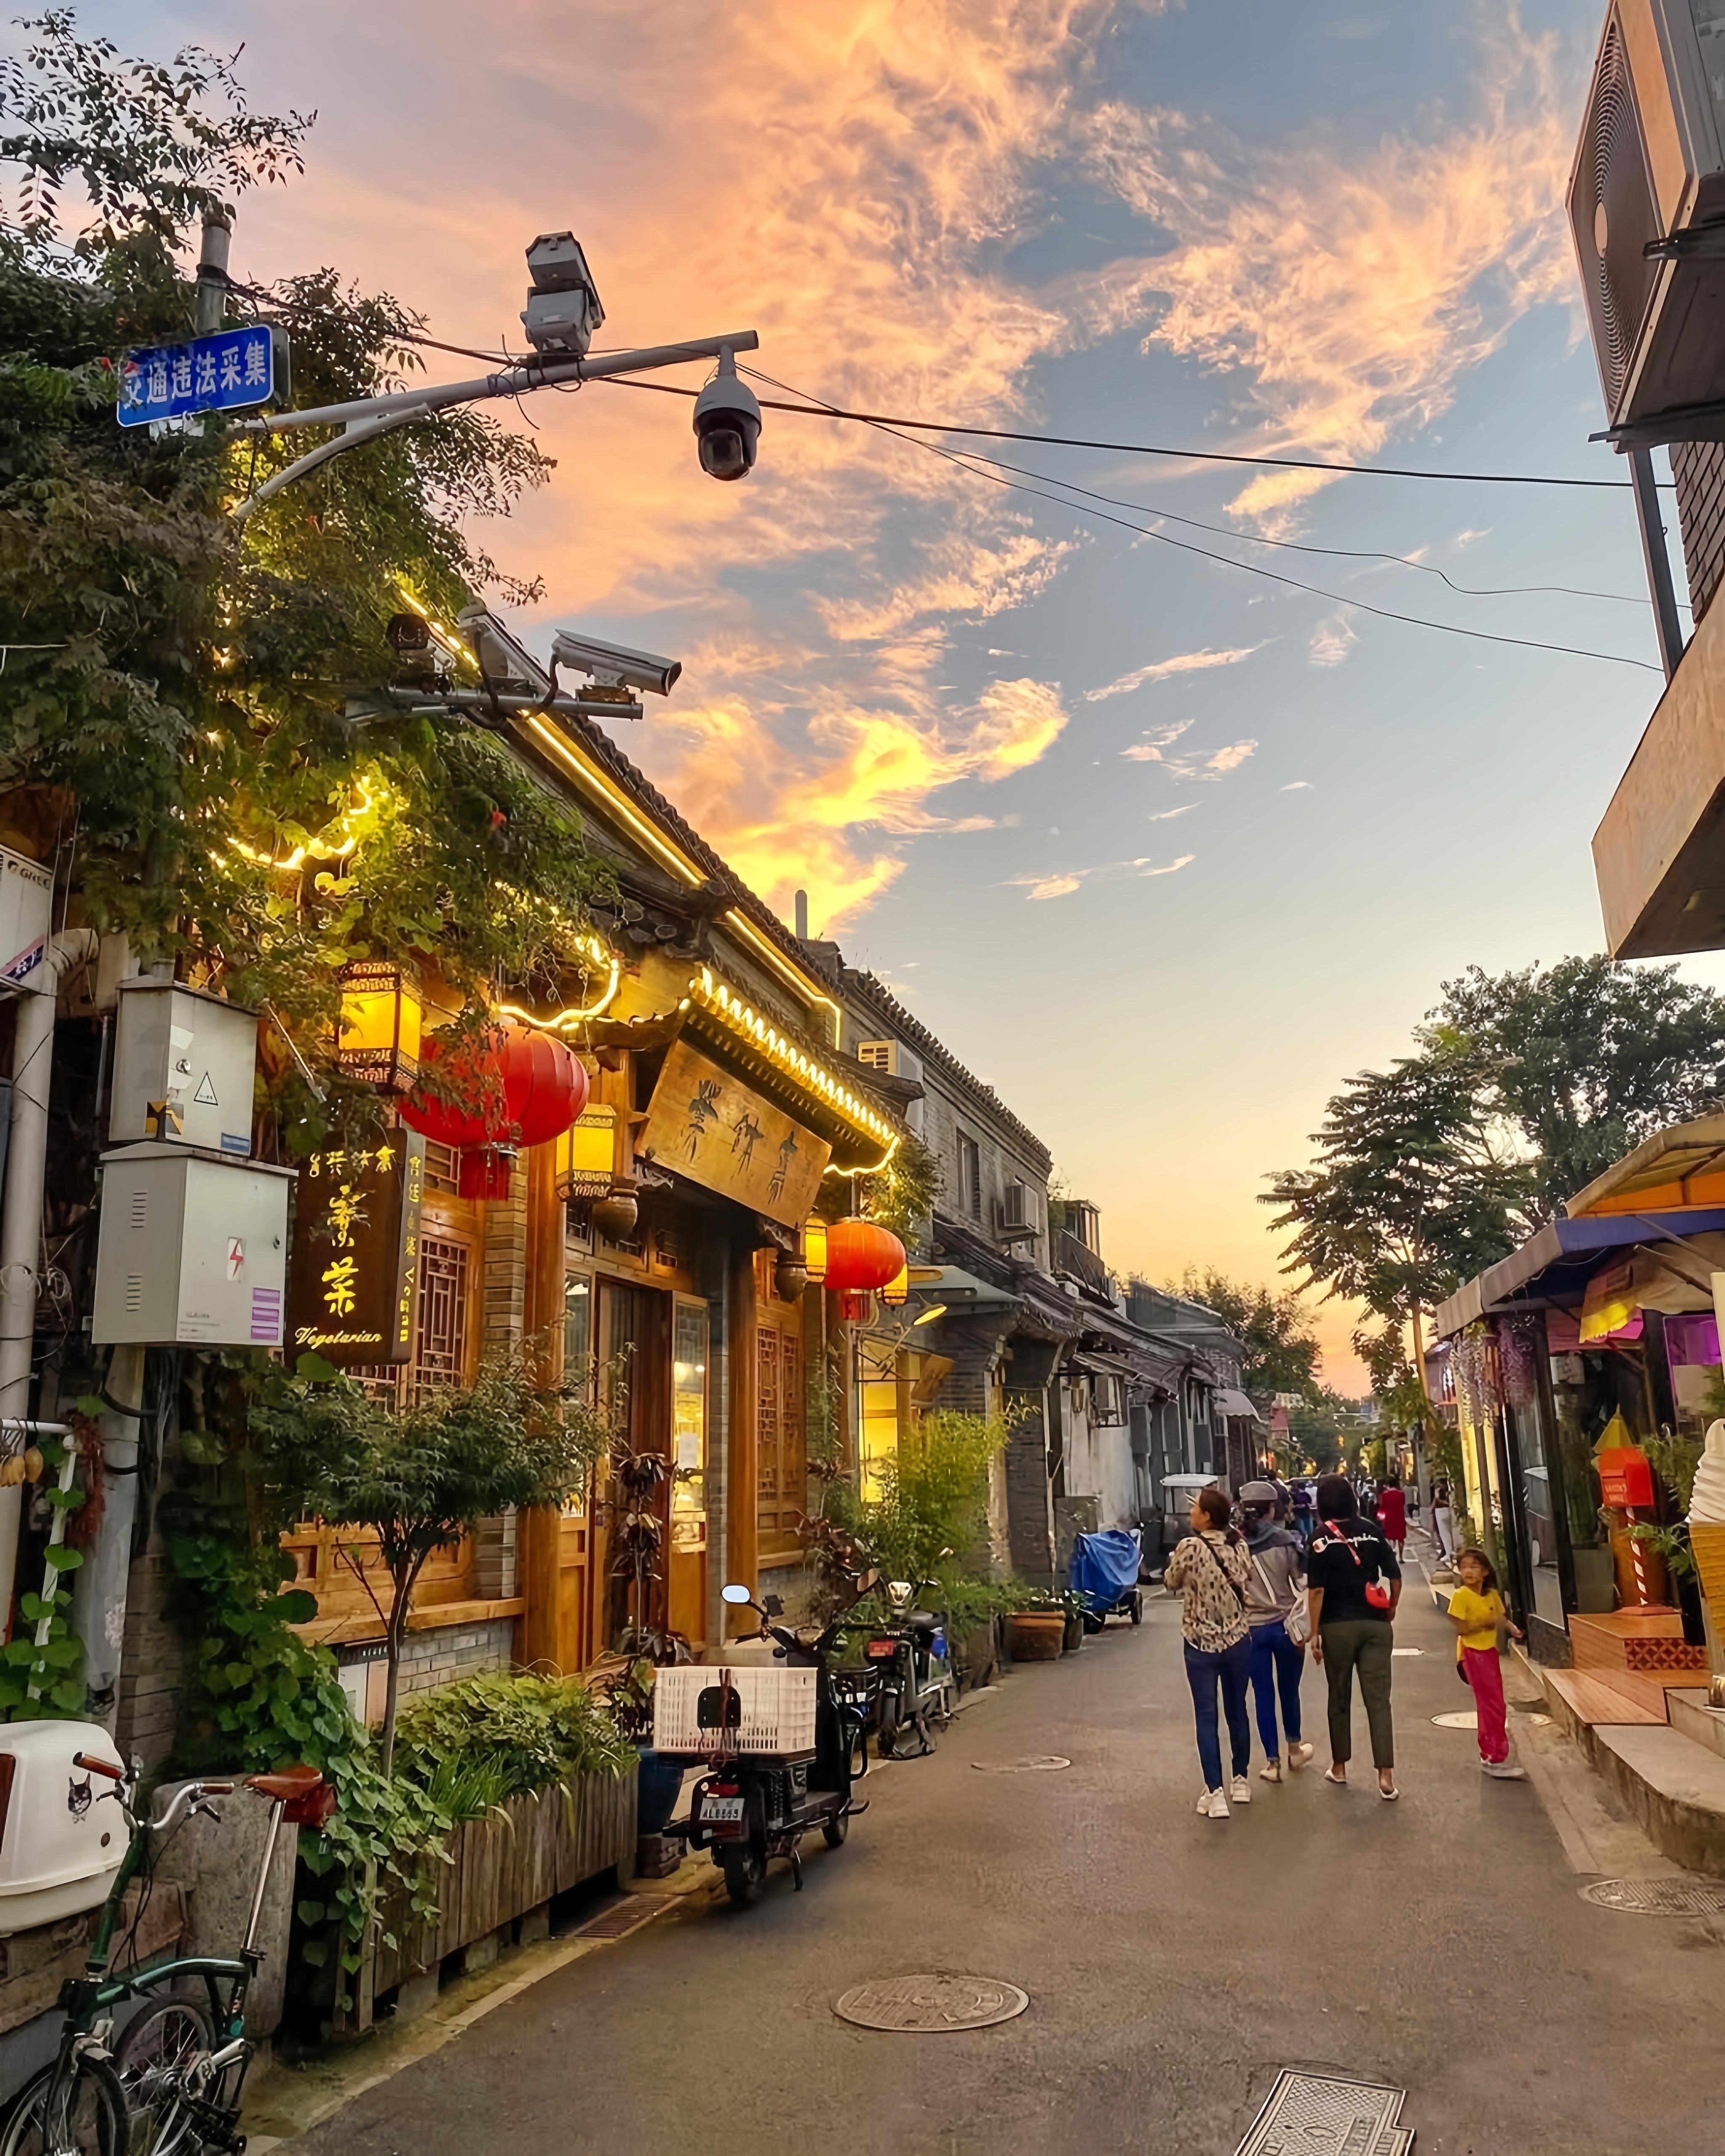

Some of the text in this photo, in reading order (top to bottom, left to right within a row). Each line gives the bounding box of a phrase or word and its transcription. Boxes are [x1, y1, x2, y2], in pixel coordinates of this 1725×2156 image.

[123, 340, 266, 410] 交通违法采集
[295, 1326, 382, 1350] Vegetarian
